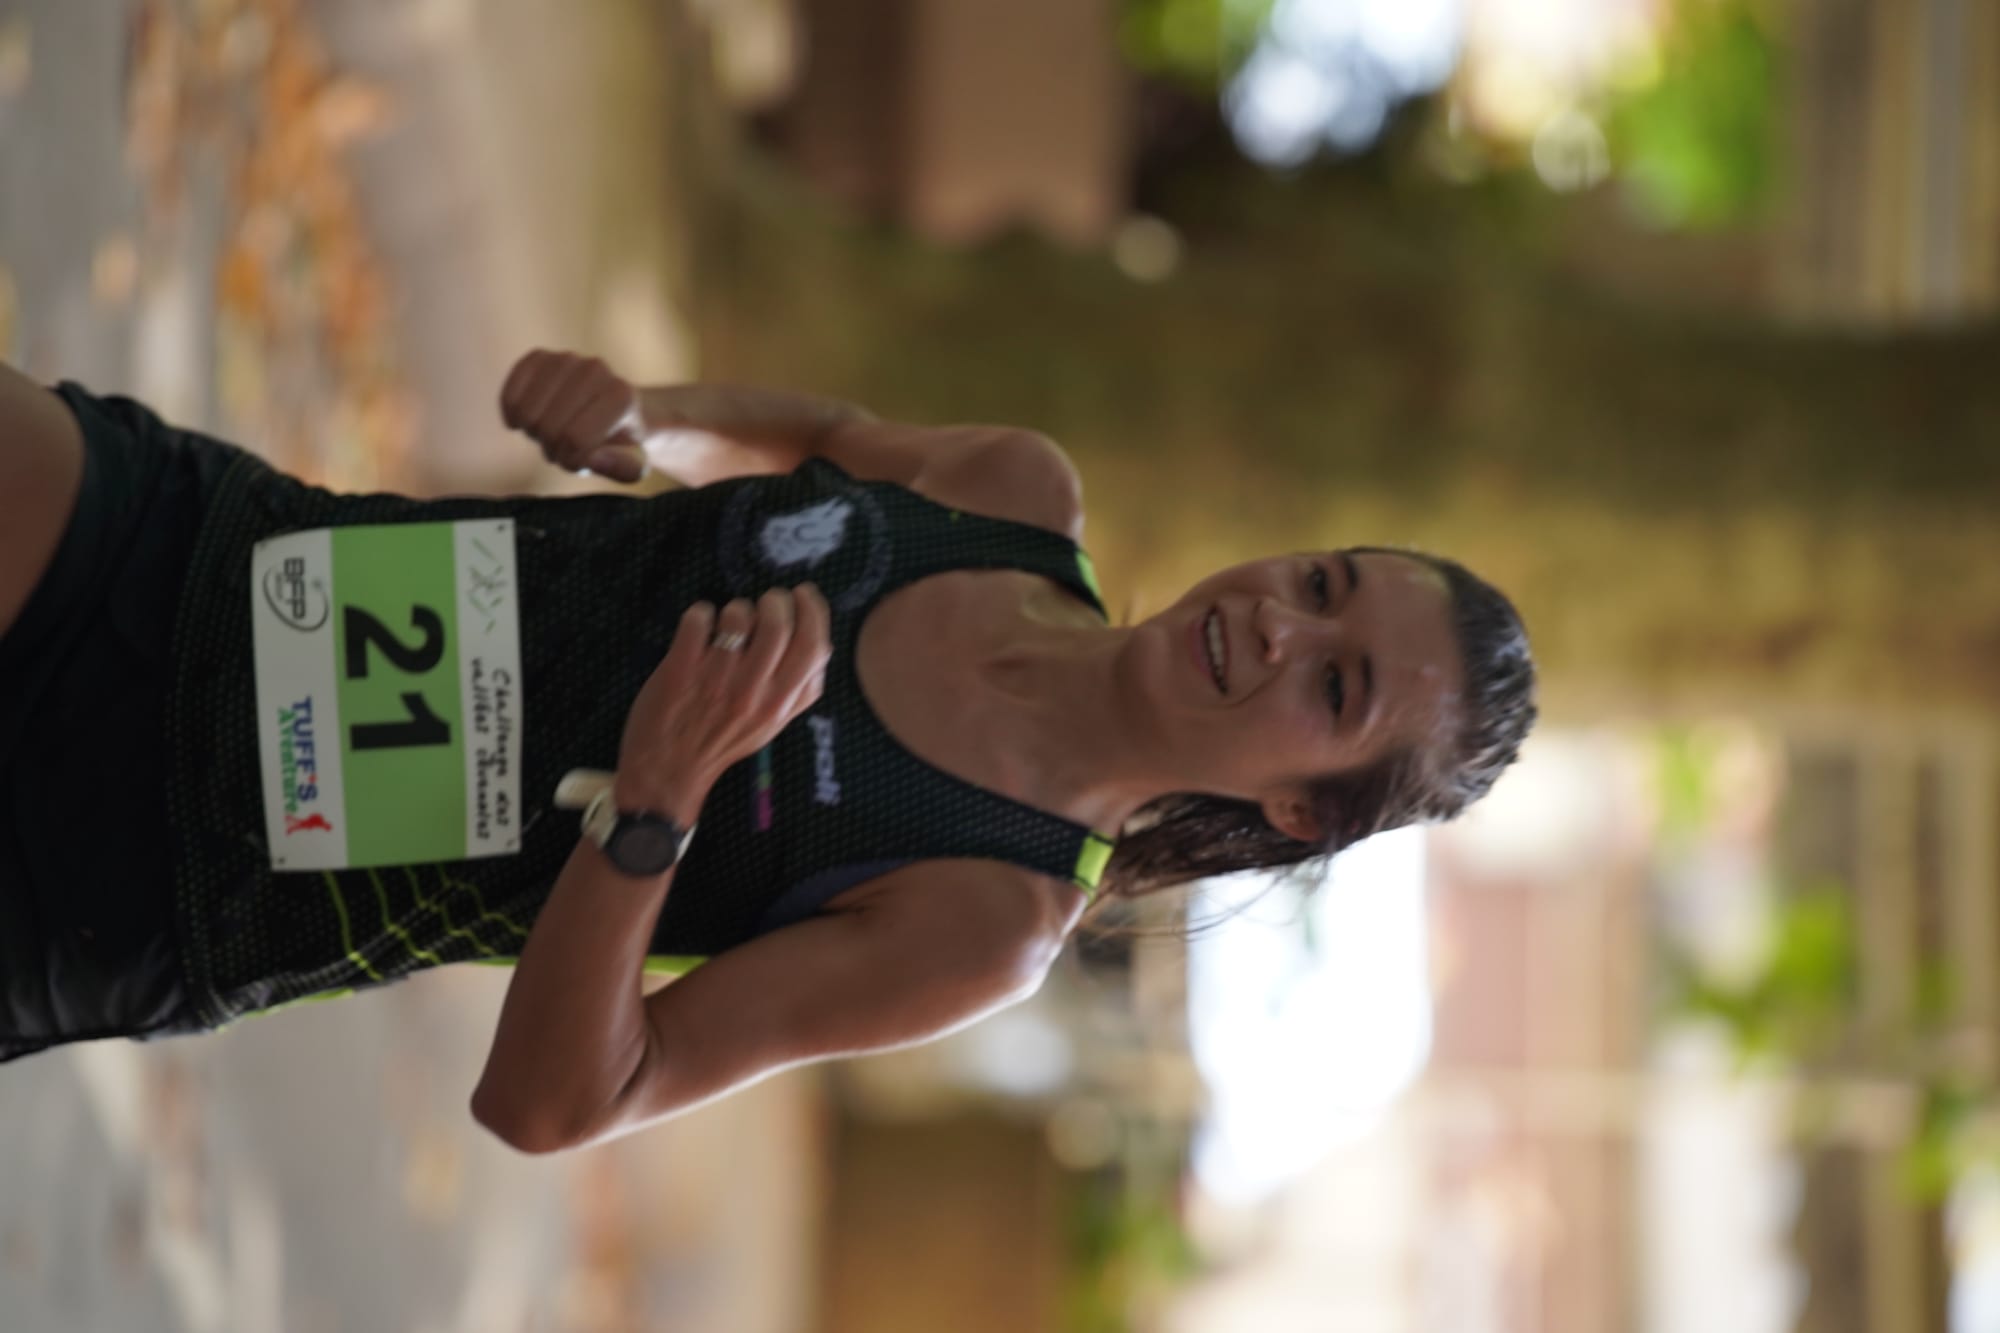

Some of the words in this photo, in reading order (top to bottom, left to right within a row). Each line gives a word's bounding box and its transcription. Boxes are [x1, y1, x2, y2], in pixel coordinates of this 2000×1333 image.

[284, 557, 305, 620] BFP
[343, 603, 452, 752] 21
[490, 669, 513, 777] Challenge
[277, 707, 299, 813] Aventure
[292, 696, 318, 802] TUFF'S
[807, 714, 841, 806] poli
[495, 790, 509, 827] des
